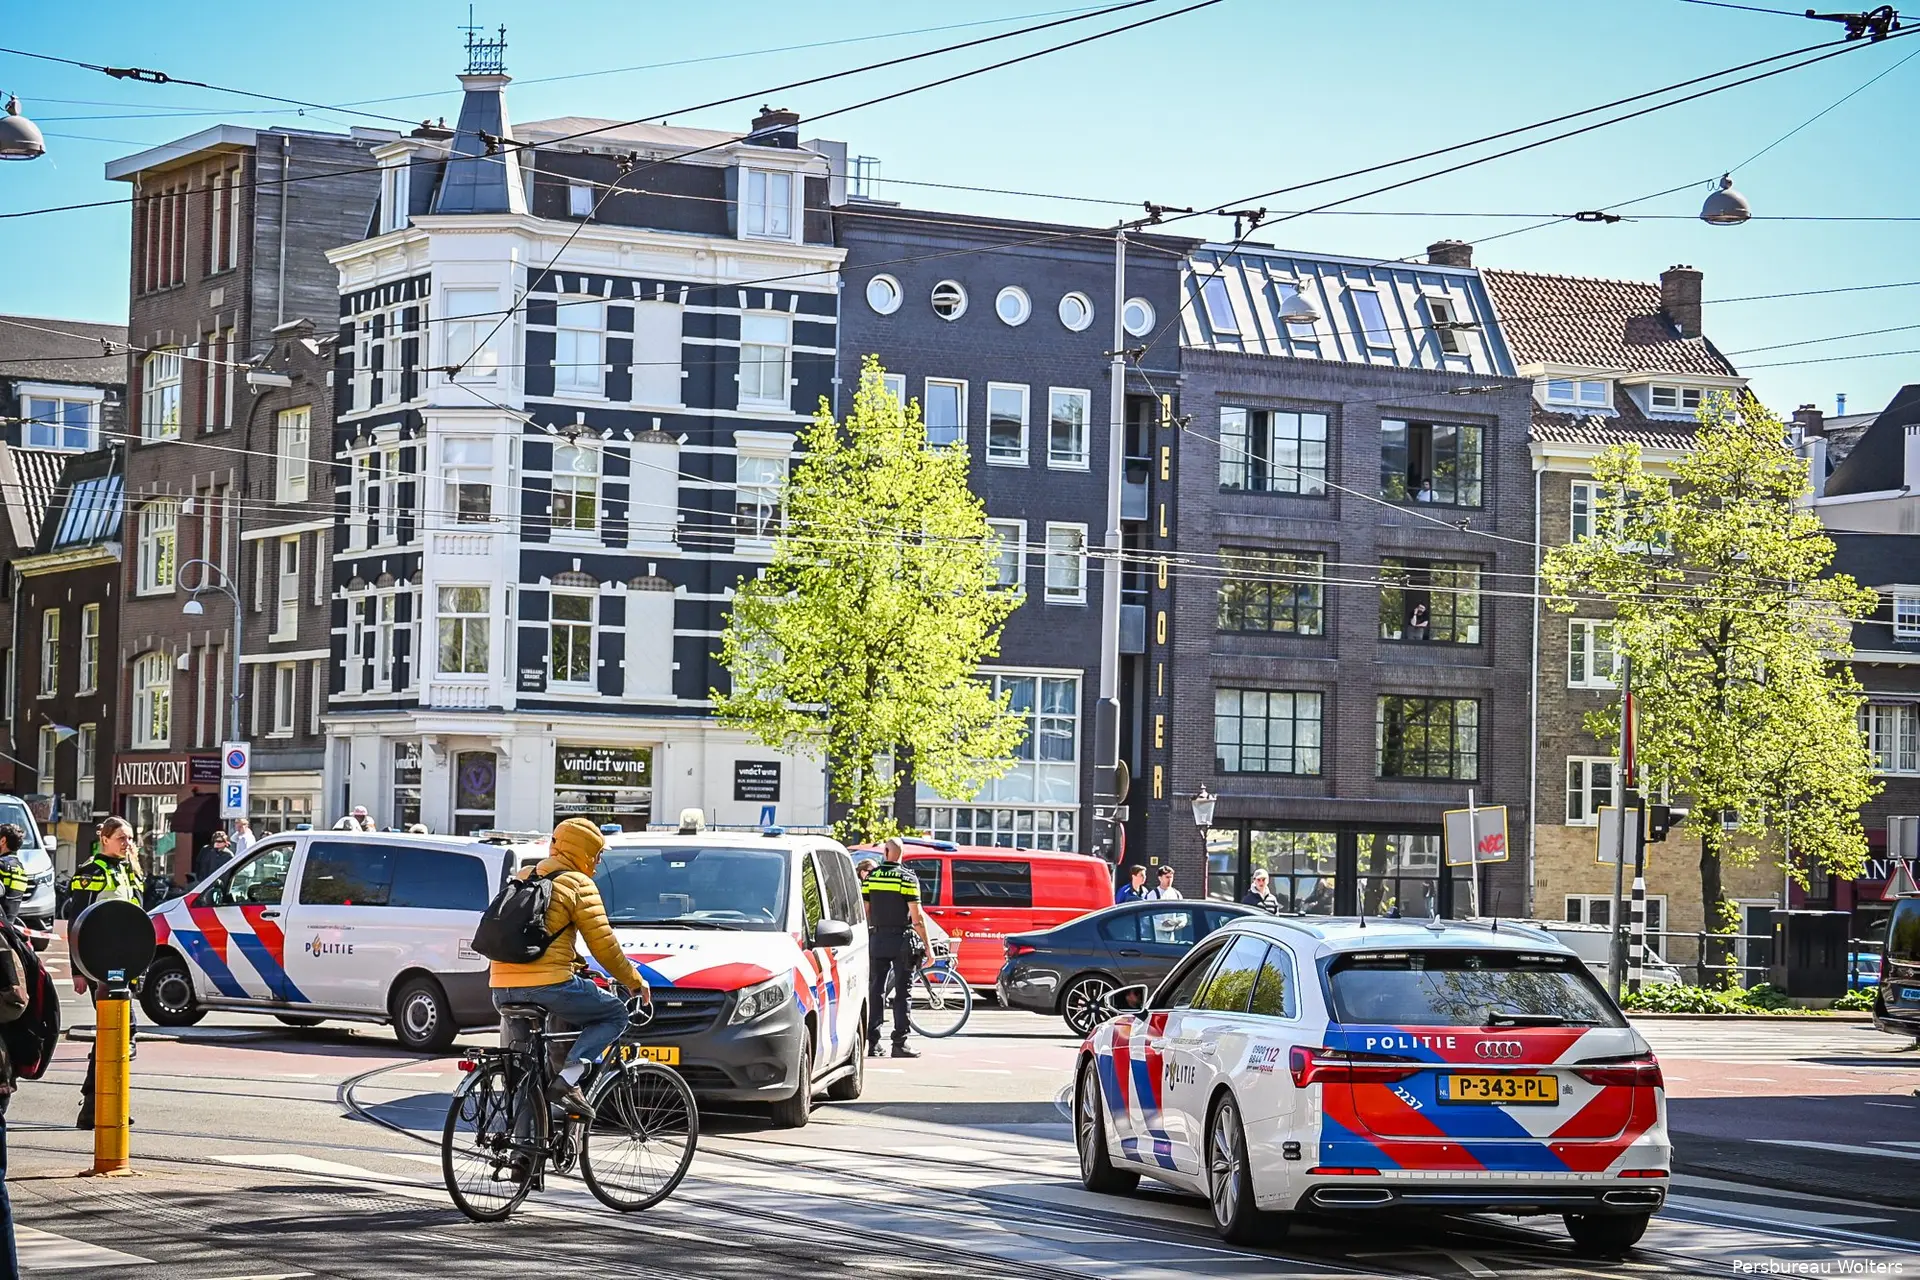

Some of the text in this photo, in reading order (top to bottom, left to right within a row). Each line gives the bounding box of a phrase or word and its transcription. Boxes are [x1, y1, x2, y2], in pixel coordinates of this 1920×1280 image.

[563, 756, 646, 773] vindict wine
[114, 761, 187, 786] ANTIEKCENT
[230, 786, 239, 799] P
[1856, 858, 1920, 880] ANTI
[305, 941, 354, 957] POLITIE
[621, 942, 699, 951] OLITIE
[1366, 1036, 1457, 1050] POLITIE
[1263, 1046, 1280, 1063] 112
[1164, 1063, 1196, 1091] POLITIE
[1459, 1077, 1549, 1098] P-343-PL
[1394, 1085, 1424, 1111] 2237
